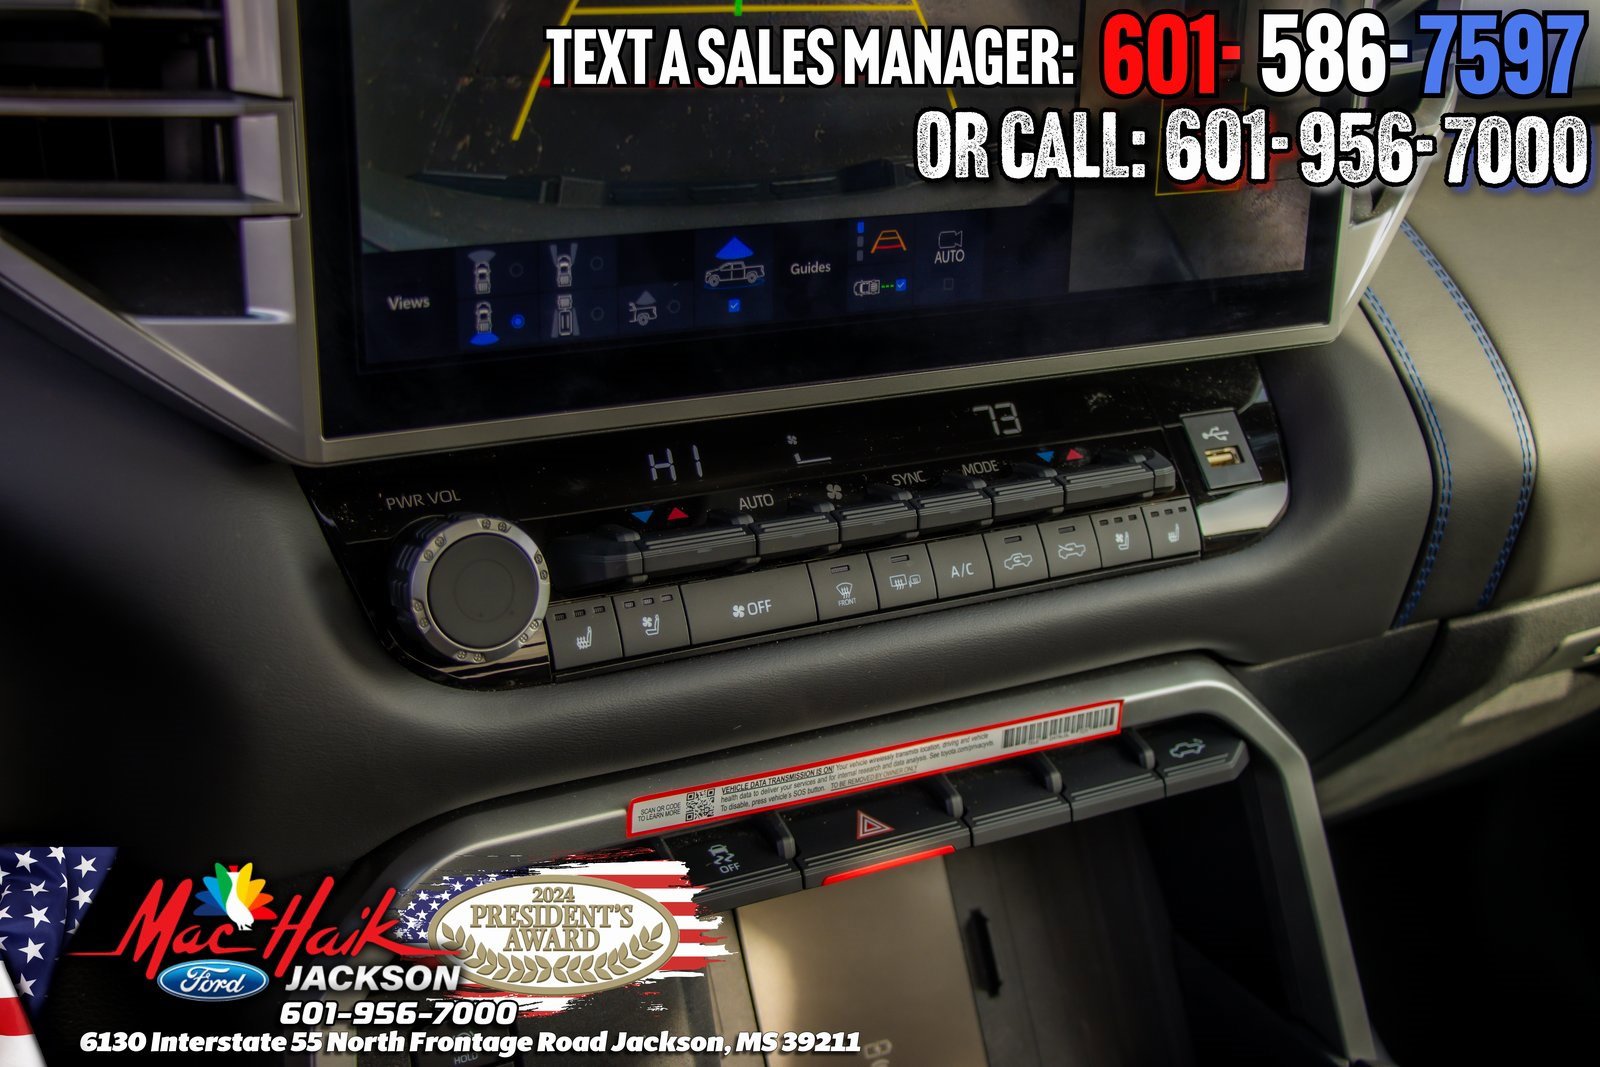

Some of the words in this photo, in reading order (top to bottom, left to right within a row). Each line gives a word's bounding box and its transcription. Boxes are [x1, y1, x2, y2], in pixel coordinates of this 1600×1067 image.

[934, 249, 965, 264] AUTO
[790, 262, 831, 276] Guides
[387, 296, 430, 311] Views
[972, 402, 1022, 436] 73
[961, 460, 999, 477] MODE
[892, 470, 926, 486] SYNC
[386, 493, 425, 511] PWR
[427, 489, 461, 505] VOL
[739, 493, 774, 511] AUTO
[951, 562, 974, 578] A/C
[747, 599, 772, 616] OFF
[838, 598, 857, 607] FRONT
[721, 783, 749, 794] VEHICLE
[750, 779, 767, 789] DATA
[768, 770, 815, 785] TRANSMISSION
[849, 759, 868, 768] vehicle
[869, 753, 894, 764] wirelessly
[896, 748, 918, 758] transmits
[960, 736, 970, 744] and
[721, 794, 738, 803] health
[740, 791, 752, 800] data
[753, 789, 759, 797] to
[761, 786, 779, 795] deliver
[780, 784, 792, 793] your
[793, 779, 816, 789] services
[817, 776, 827, 784] and
[837, 769, 857, 779] internal
[858, 764, 881, 774] research
[882, 761, 893, 769] and
[894, 759, 904, 767] data
[930, 751, 939, 760] See
[720, 804, 728, 812] To
[751, 797, 767, 807] press
[793, 788, 806, 797] SOS
[831, 781, 839, 790] TO
[848, 775, 874, 786] REMOVED
[641, 806, 656, 816] SCAN
[666, 802, 681, 811] CODE
[646, 812, 664, 820] LEARN
[665, 808, 681, 816] MORE
[719, 862, 741, 874] OFF
[453, 1053, 478, 1065] HOLD
